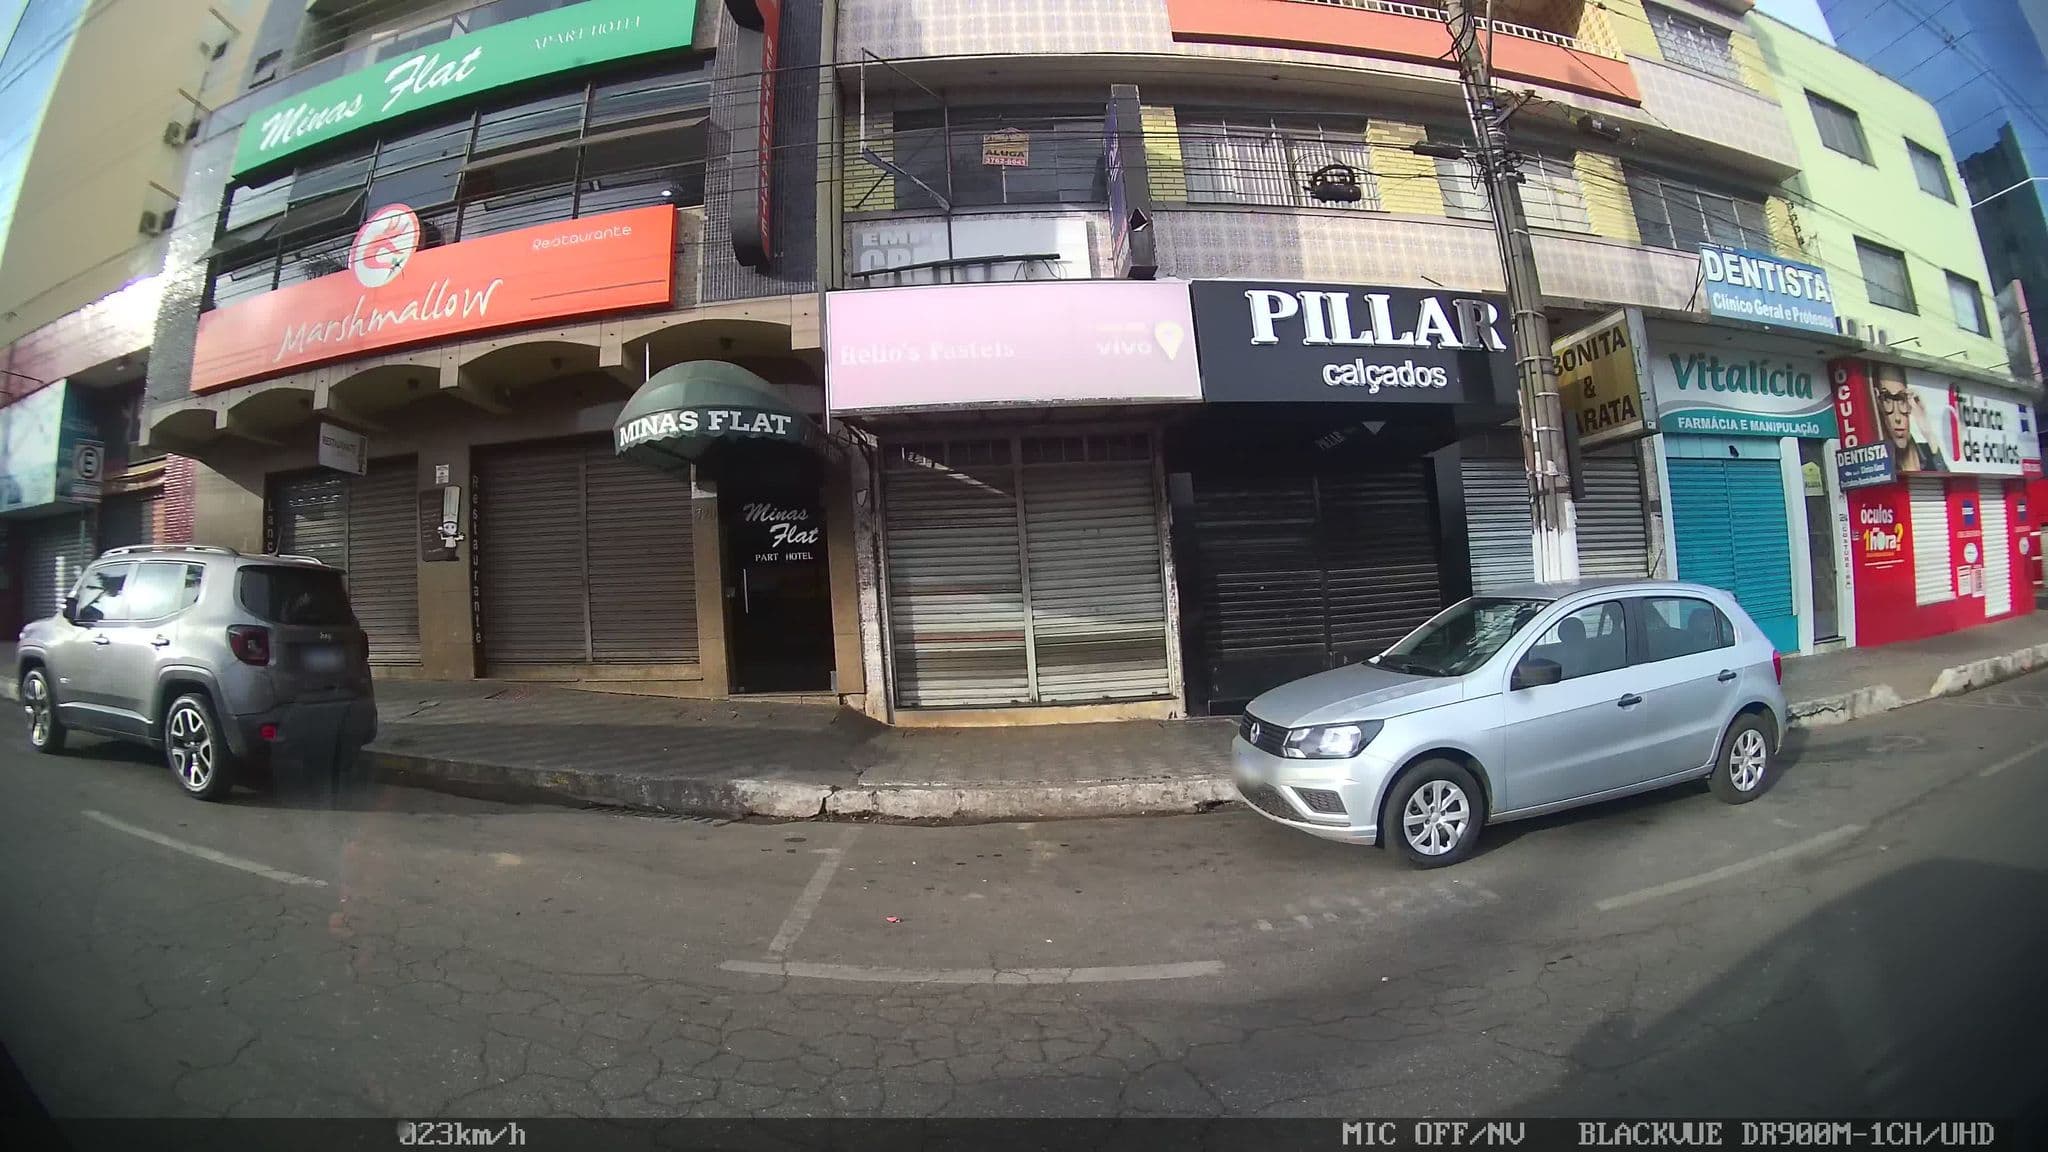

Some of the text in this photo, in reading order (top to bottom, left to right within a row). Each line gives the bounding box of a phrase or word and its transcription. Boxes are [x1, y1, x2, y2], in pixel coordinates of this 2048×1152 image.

[259, 45, 484, 151] Minas Flat
[985, 149, 1025, 158] ALUGA
[531, 224, 633, 252] Restaurante
[1701, 247, 1832, 303] DENTISTA
[273, 277, 504, 364] Marshmallow
[1244, 289, 1507, 352] PILLAR
[1712, 292, 1753, 314] Clínico
[1753, 299, 1784, 321] Geral
[1784, 308, 1792, 321] e
[1322, 358, 1449, 394] calçados
[1584, 375, 1597, 398] &
[1668, 352, 1814, 400] Vitalícia
[619, 410, 792, 447] MINAS FLAT
[1677, 414, 1820, 436] FARMÁCIA E MANIPULAÇÃO
[1836, 444, 1889, 468] DENTISTA
[1963, 430, 1981, 463] de
[743, 503, 809, 522] Minas
[1860, 503, 1894, 525] óculos
[769, 523, 819, 549] Flat
[785, 551, 814, 561] HOTEL
